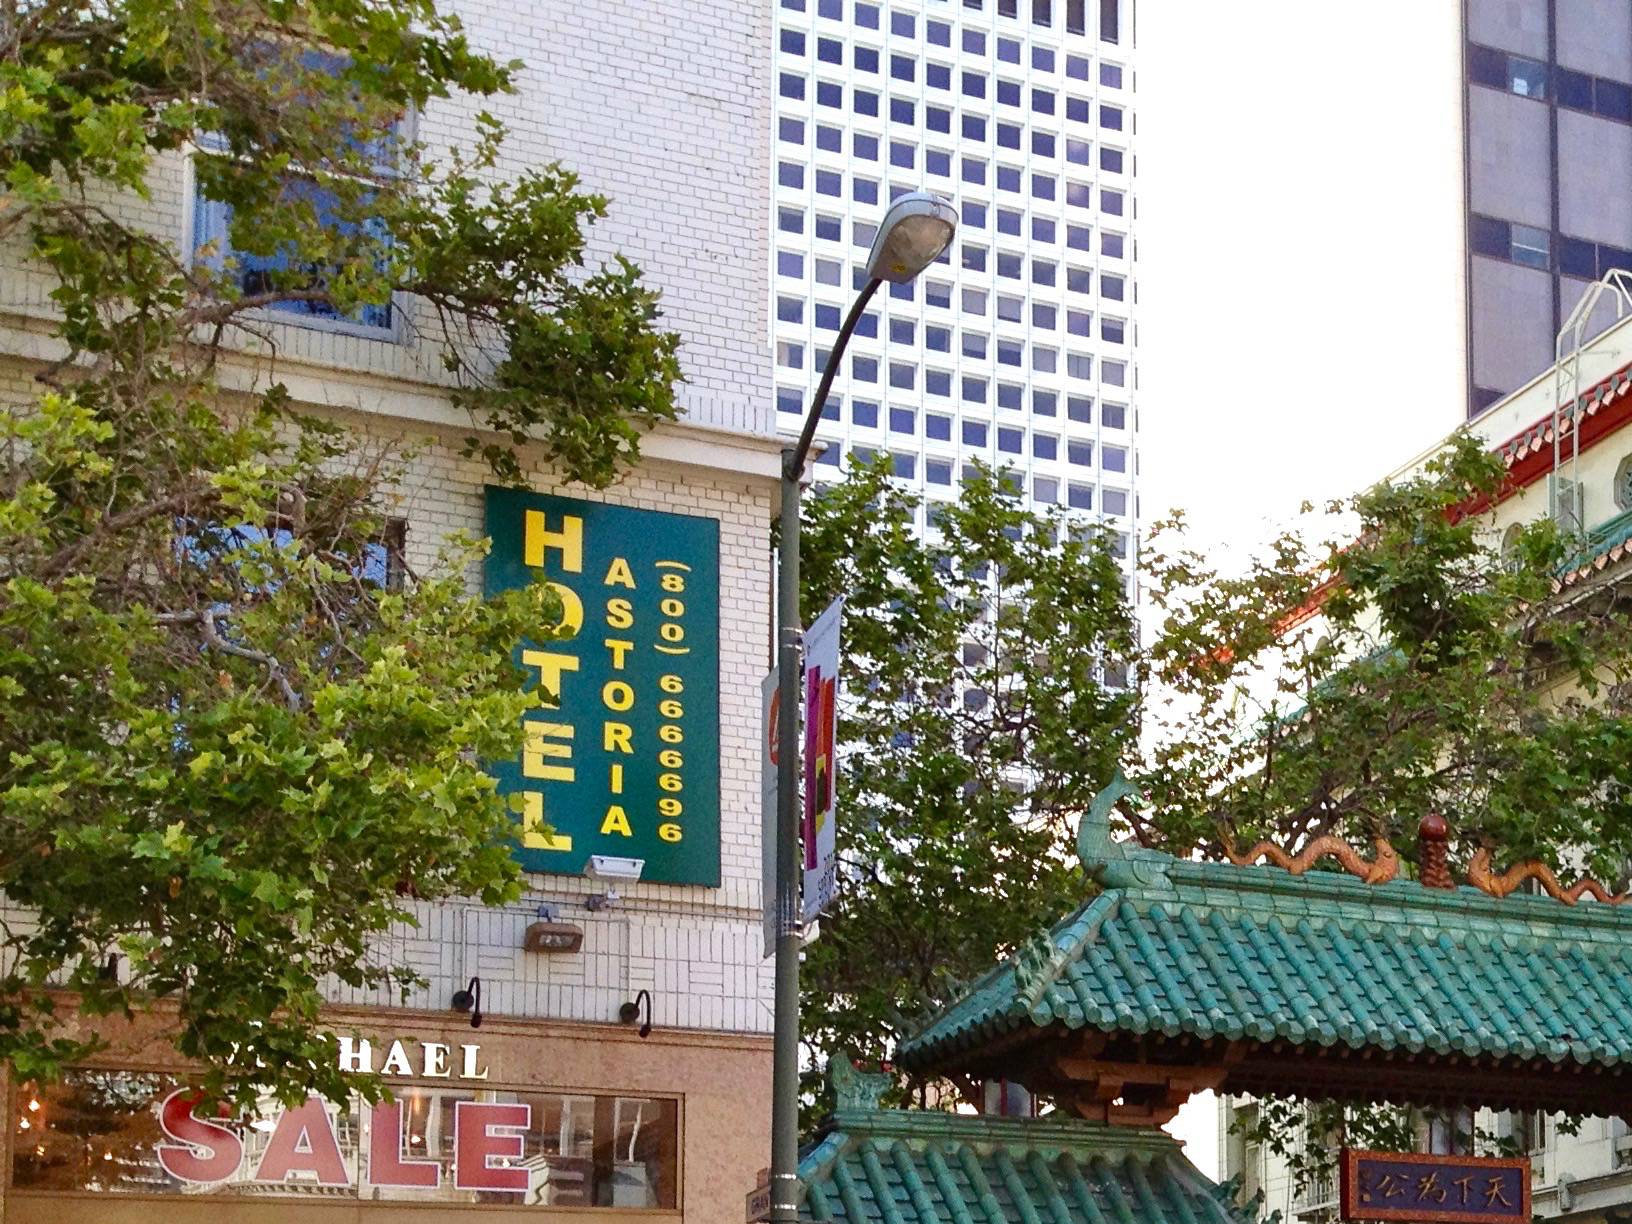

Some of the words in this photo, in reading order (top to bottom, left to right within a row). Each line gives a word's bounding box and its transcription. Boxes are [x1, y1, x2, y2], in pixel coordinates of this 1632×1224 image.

[654, 560, 692, 655] (800)
[600, 557, 637, 838] ASTORIA
[156, 1087, 532, 1192] SALE
